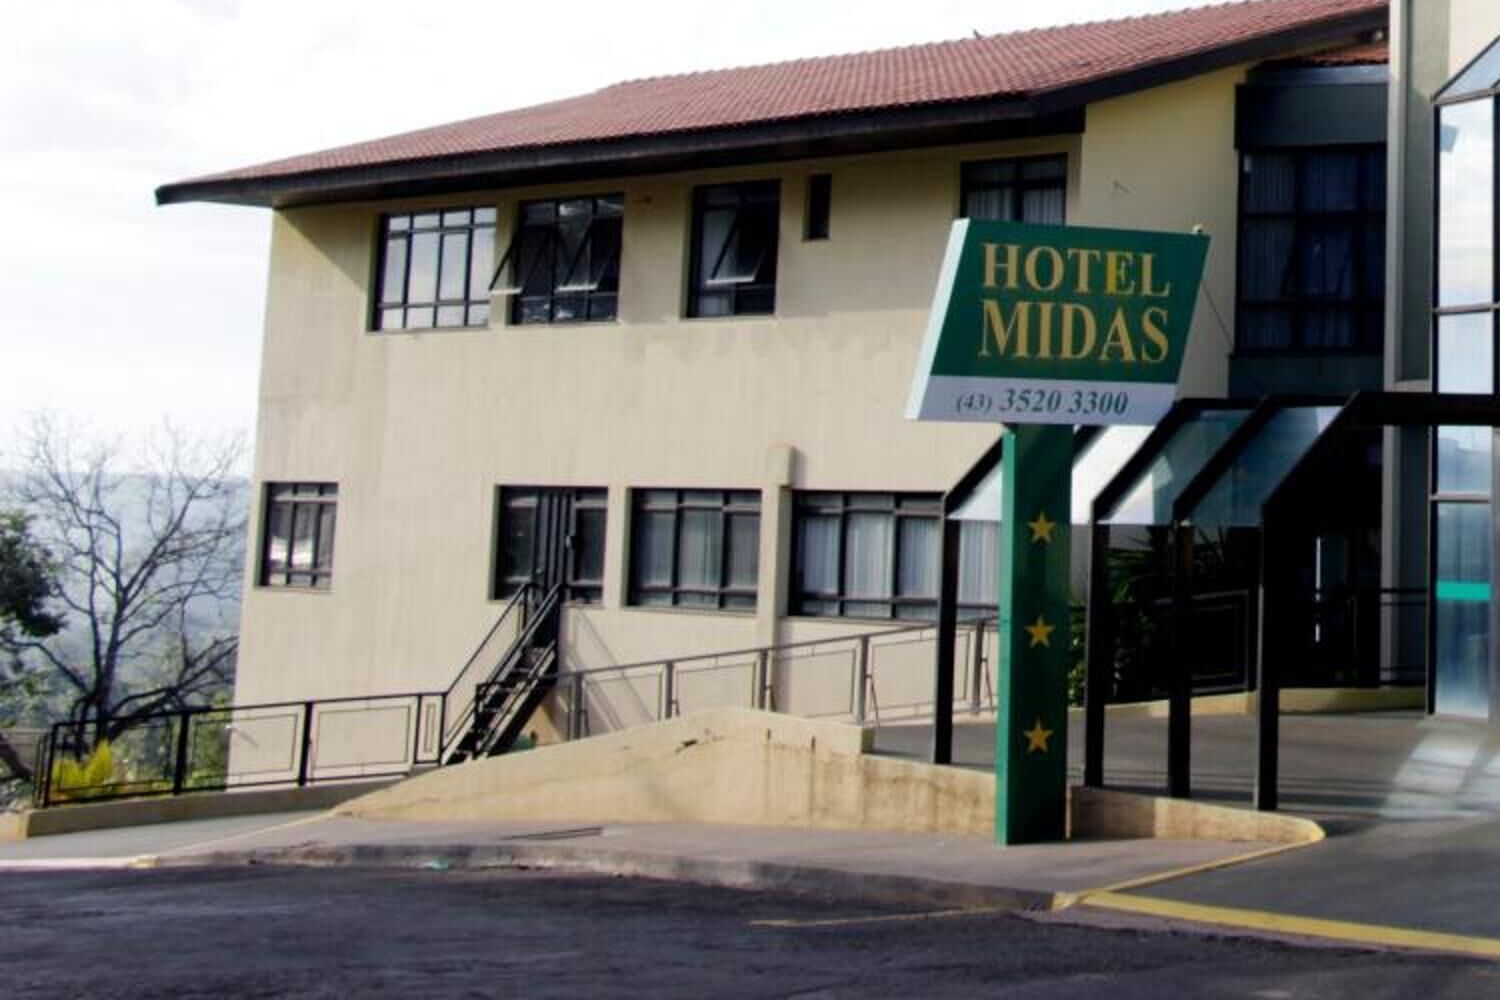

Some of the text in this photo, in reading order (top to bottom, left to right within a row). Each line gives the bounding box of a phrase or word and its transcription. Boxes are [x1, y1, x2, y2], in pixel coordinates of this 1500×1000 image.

[981, 243, 1170, 297] HOTEL
[977, 300, 1169, 363] MIDAS
[956, 388, 1128, 414] (43) 3520 3300
